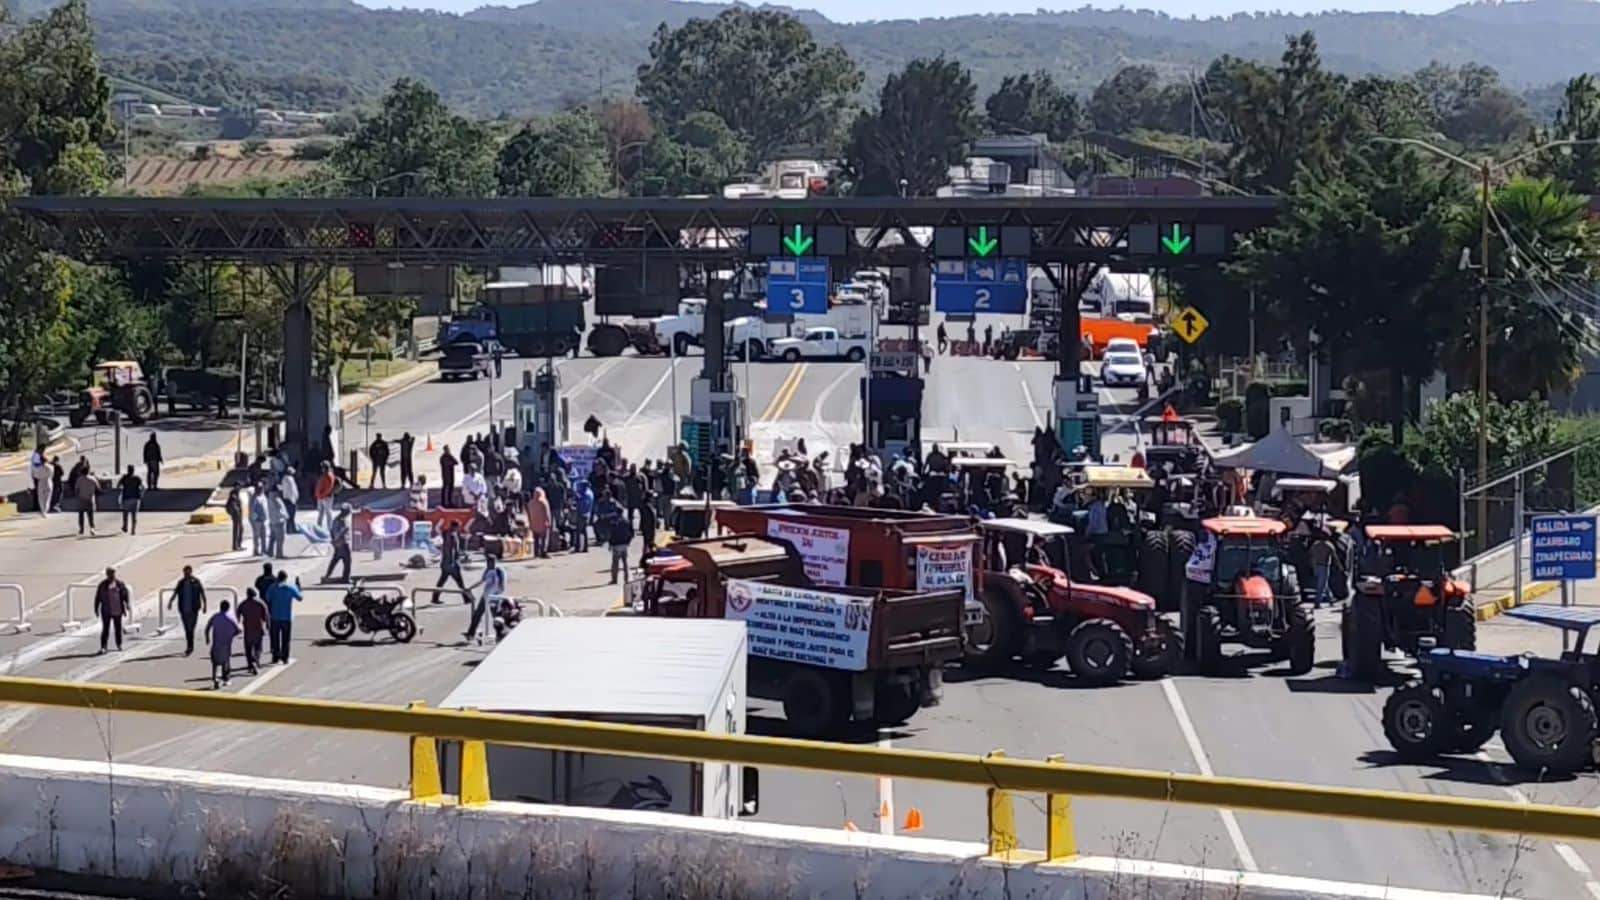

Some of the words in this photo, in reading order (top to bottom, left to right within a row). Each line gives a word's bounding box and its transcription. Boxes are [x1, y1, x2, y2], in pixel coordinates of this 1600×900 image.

[789, 287, 805, 309] 3
[974, 288, 991, 308] 2
[1535, 520, 1570, 533] SALIDA
[760, 611, 776, 620] ALTO
[783, 613, 792, 622] LA
[780, 625, 788, 633] DE
[769, 648, 794, 659] BLANCO
[795, 652, 827, 664] NACIONAL
[783, 639, 806, 650] PRECIO
[807, 642, 828, 653] JUSTO
[829, 645, 846, 656] PARA
[847, 648, 855, 658] EL
